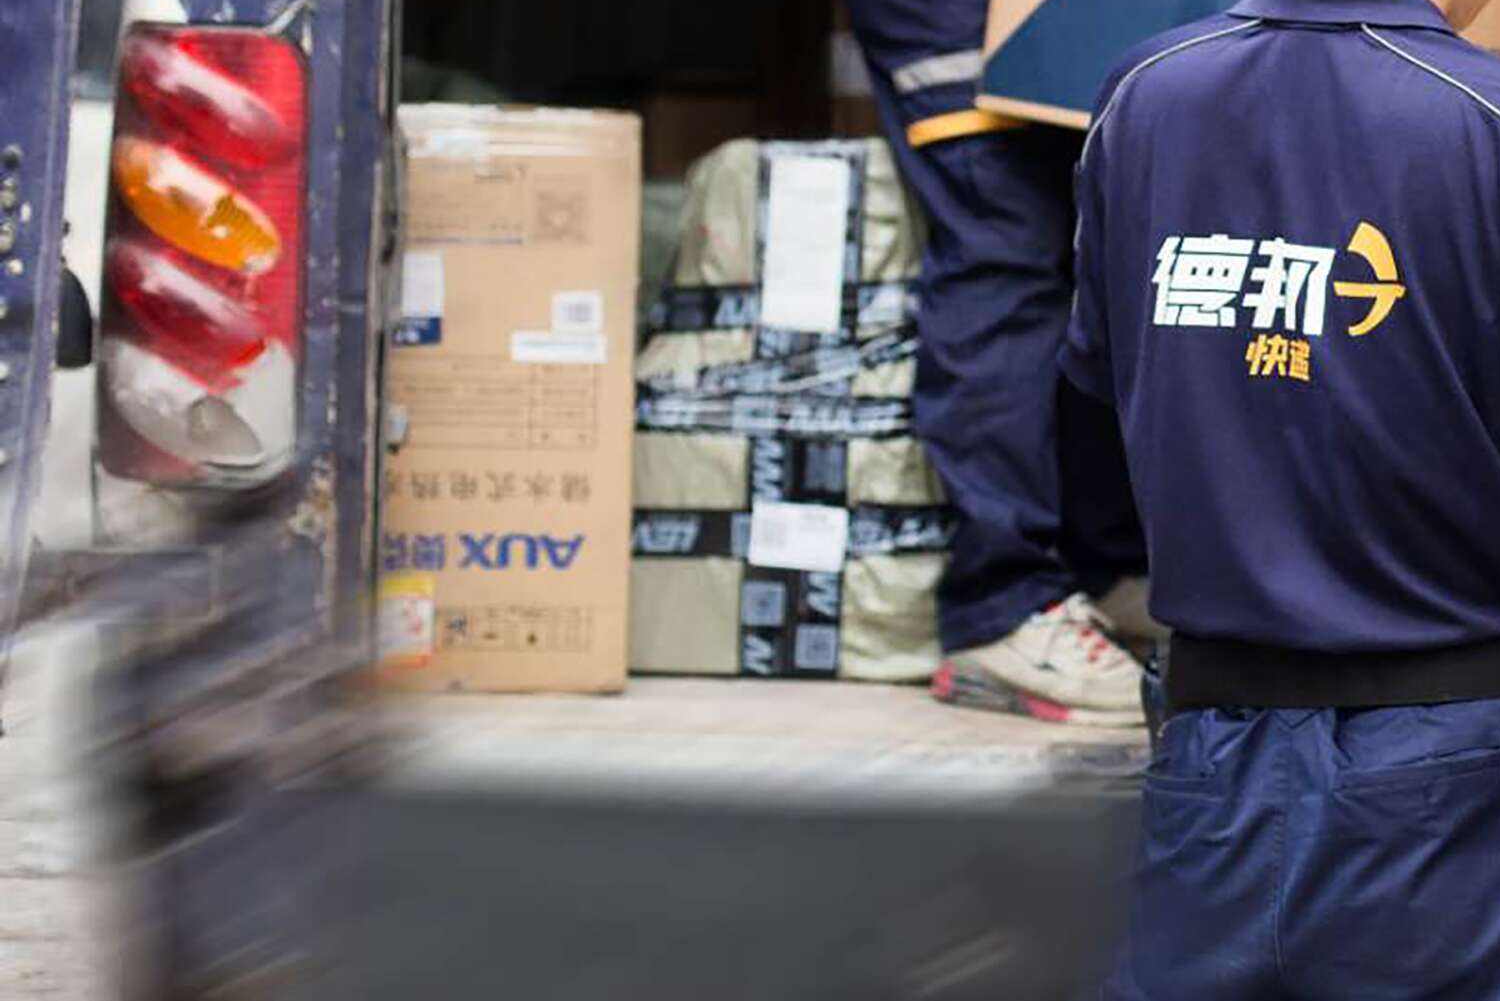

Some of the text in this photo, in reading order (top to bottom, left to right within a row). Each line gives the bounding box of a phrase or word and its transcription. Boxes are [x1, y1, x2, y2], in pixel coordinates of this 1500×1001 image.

[1152, 233, 1337, 336] 德邦
[1245, 334, 1311, 382] 快递
[457, 532, 585, 570] AUX
